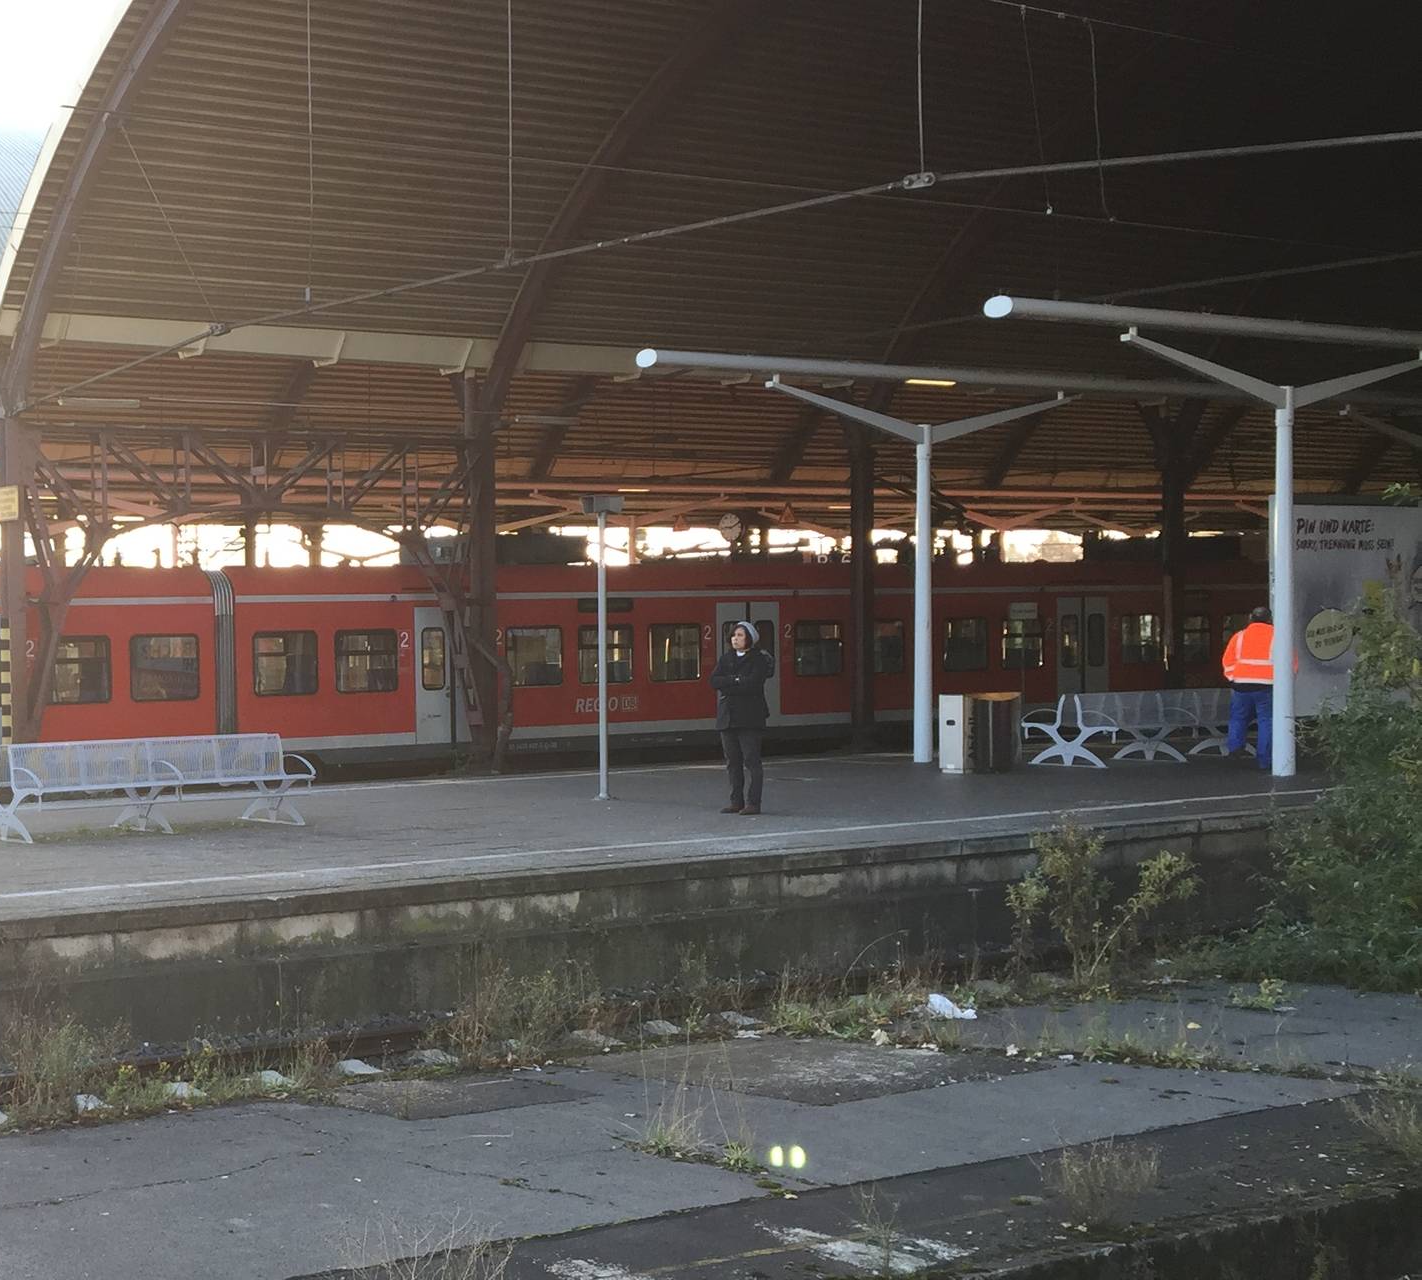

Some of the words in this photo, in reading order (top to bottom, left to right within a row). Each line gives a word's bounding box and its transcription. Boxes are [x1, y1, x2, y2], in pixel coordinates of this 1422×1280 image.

[1297, 518, 1316, 535] PIN
[1319, 519, 1339, 535] UND
[1342, 519, 1375, 535] KARTE:
[704, 624, 712, 640] 2
[784, 623, 792, 638] 2
[400, 631, 409, 648] 2
[25, 640, 35, 657] 2
[575, 696, 619, 713] REGO
